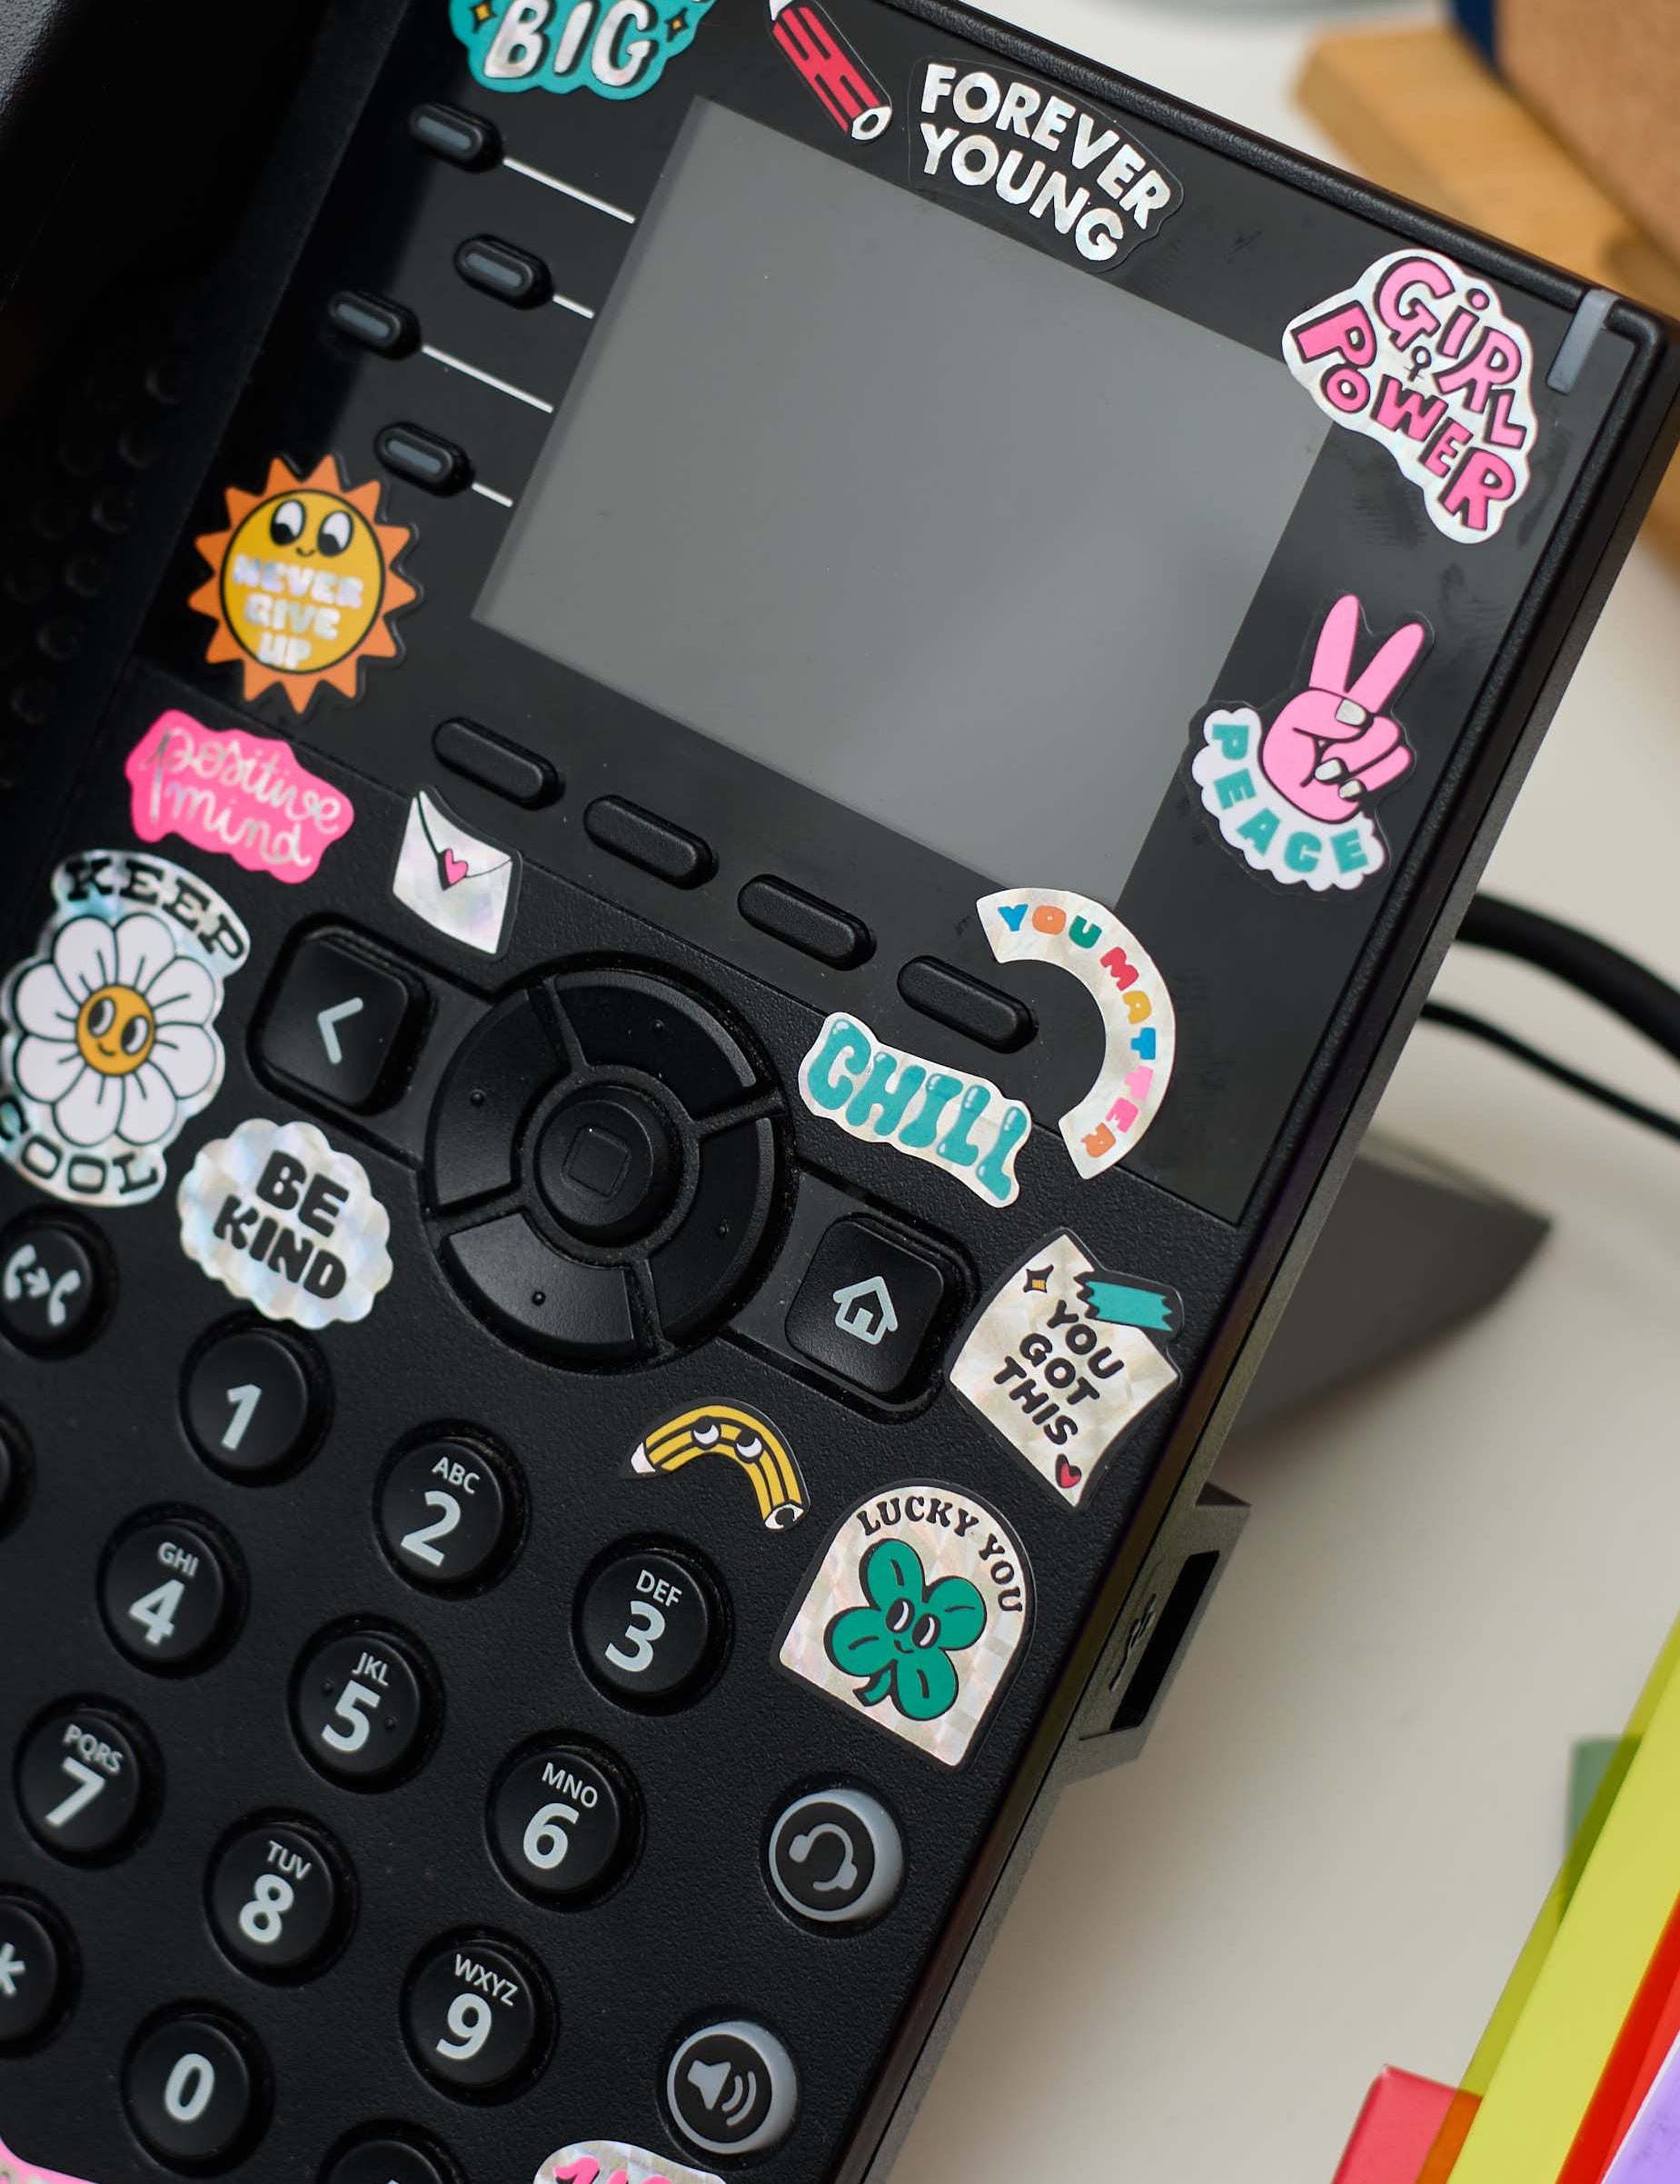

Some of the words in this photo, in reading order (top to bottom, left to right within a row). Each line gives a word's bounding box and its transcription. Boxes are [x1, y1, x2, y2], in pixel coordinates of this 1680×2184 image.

[483, 0, 659, 88] BIG
[920, 63, 1171, 230] FOREVER
[920, 123, 1125, 262] YOUNG
[1290, 299, 1516, 532] POWER
[233, 553, 364, 610] NEVER
[244, 593, 341, 641] GIVE
[256, 632, 312, 670] UP
[140, 727, 342, 834] positive
[1212, 723, 1368, 874] PEACE
[164, 782, 312, 868] mind
[65, 857, 245, 960] KEEP
[998, 904, 1102, 949] YOU
[1079, 946, 1157, 1158] MATTER
[0, 1092, 158, 1195] COOL
[807, 1018, 1028, 1202] CHILL
[255, 1149, 350, 1238] BE
[213, 1194, 347, 1300] KIND
[1019, 1332, 1100, 1405] GOT
[1047, 1300, 1125, 1380] YOU
[222, 1383, 263, 1451] 1
[993, 1355, 1079, 1446] THIS
[431, 1456, 481, 1495] ABC
[157, 1541, 200, 1578] GHI
[400, 1490, 462, 1567] 2
[856, 1496, 979, 1537] LUCKY
[978, 1533, 1023, 1613] YOU
[128, 1579, 185, 1647] 4
[636, 1569, 682, 1607] DEF
[351, 1650, 390, 1688] JKL
[604, 1600, 666, 1672] 3
[62, 1722, 125, 1777] PQRS
[321, 1679, 381, 1752] 5
[45, 1756, 106, 1829] 7
[542, 1761, 598, 1809] MNO
[266, 1840, 313, 1880] TUV
[522, 1802, 580, 1870] 6
[239, 1873, 294, 1944] 8
[454, 1953, 518, 2007] WXYZ
[435, 1992, 492, 2060] 9
[164, 2052, 215, 2123] 0
